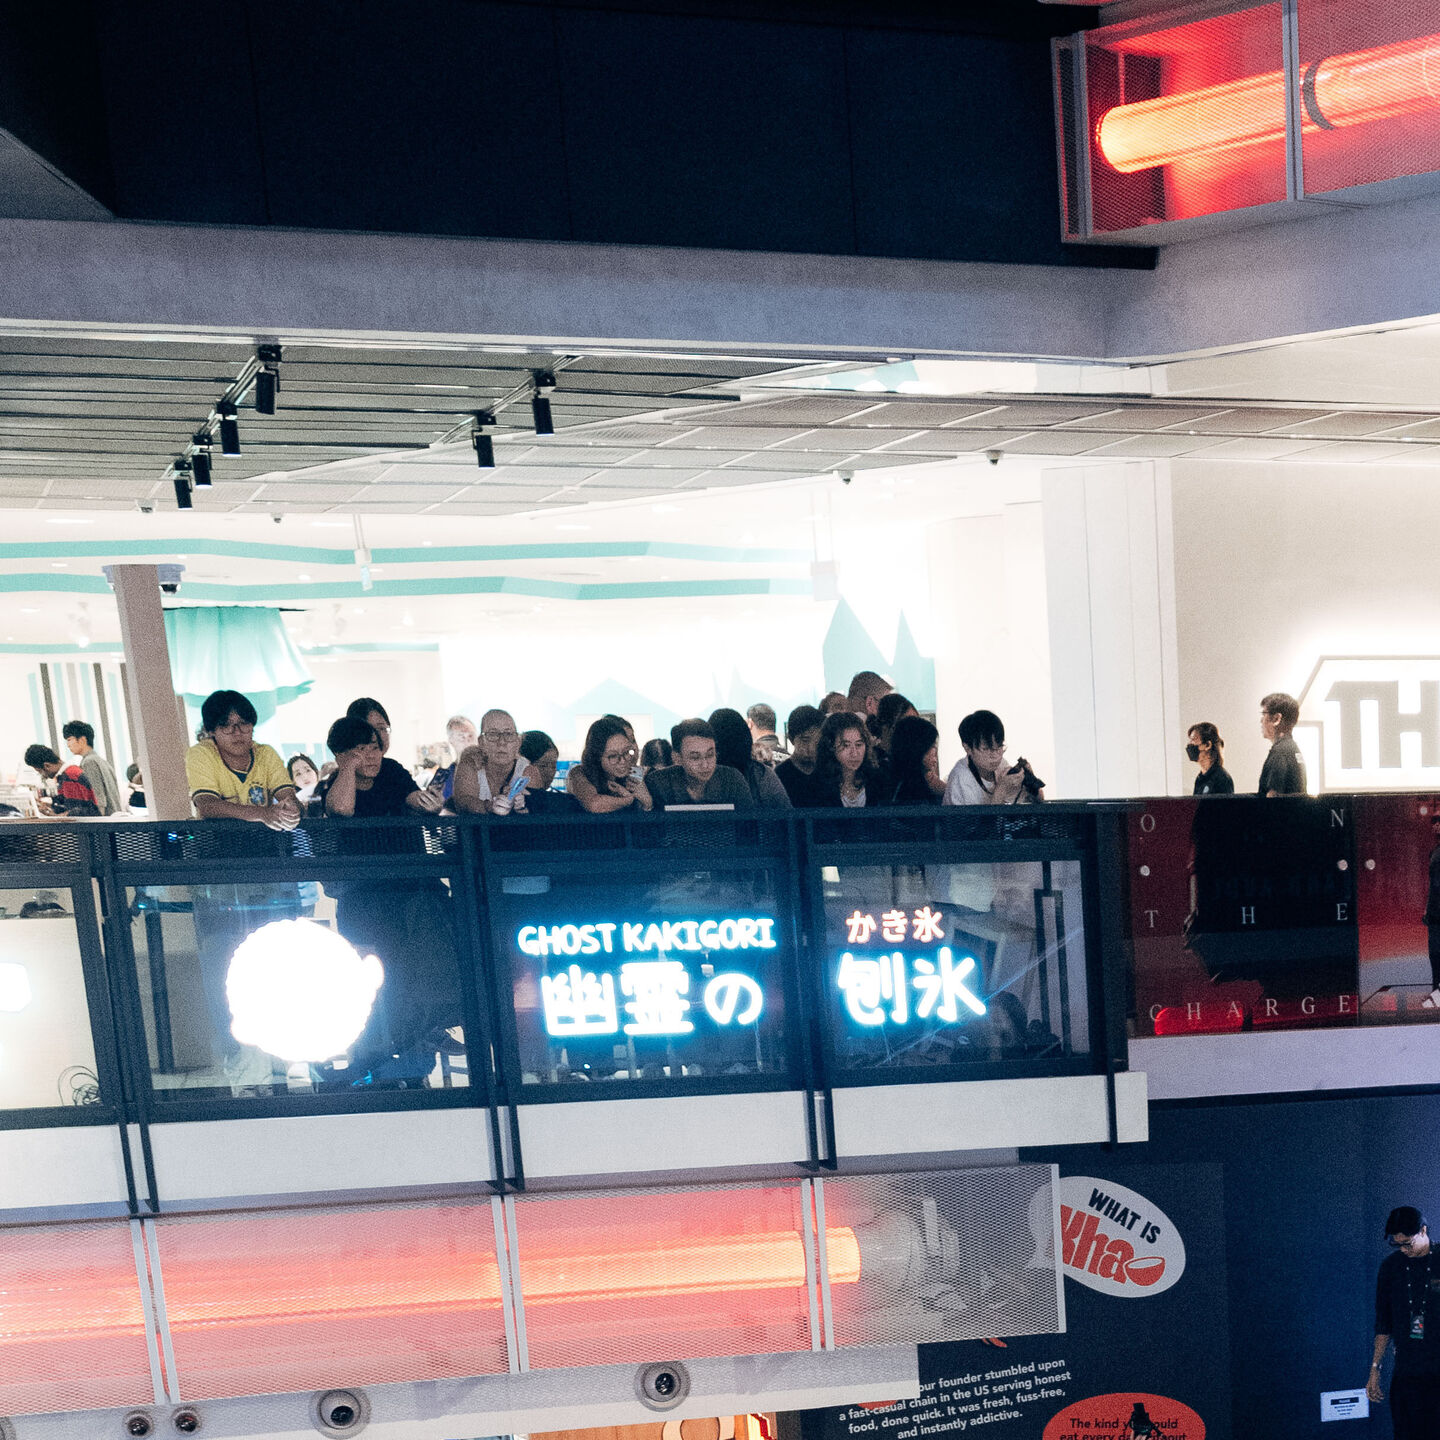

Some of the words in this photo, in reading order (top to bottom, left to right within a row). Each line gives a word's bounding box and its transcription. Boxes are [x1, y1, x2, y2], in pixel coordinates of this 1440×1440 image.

[517, 922, 617, 955] GHOST
[623, 917, 777, 952] KAKIGORI
[846, 906, 945, 943] かき氷
[1150, 995, 1351, 1021] CHARGE
[1088, 1188, 1141, 1231] WHAT
[1140, 1221, 1161, 1244] IS
[939, 1374, 982, 1388] founder
[985, 1364, 1035, 1381] stumbled
[1038, 1359, 1066, 1375] upon
[839, 1412, 846, 1421] a
[848, 1399, 906, 1419] fast-casual
[909, 1395, 937, 1410] chain
[940, 1392, 950, 1403] in
[953, 1388, 971, 1401] the
[974, 1386, 989, 1397] US
[993, 1378, 1032, 1395] serving
[1035, 1371, 1071, 1386] honest
[848, 1420, 879, 1434] food,
[882, 1414, 909, 1428] done
[912, 1410, 944, 1426] quick.
[947, 1406, 956, 1416] It
[959, 1403, 980, 1414] was
[983, 1396, 1013, 1410] fresh,
[1016, 1387, 1066, 1404] fuss-free,
[897, 1429, 917, 1440] and
[921, 1419, 967, 1436] instantly
[970, 1410, 1023, 1426] addictive.
[1070, 1418, 1091, 1429] The
[1094, 1417, 1119, 1429] kind
[1155, 1418, 1178, 1429] ould
